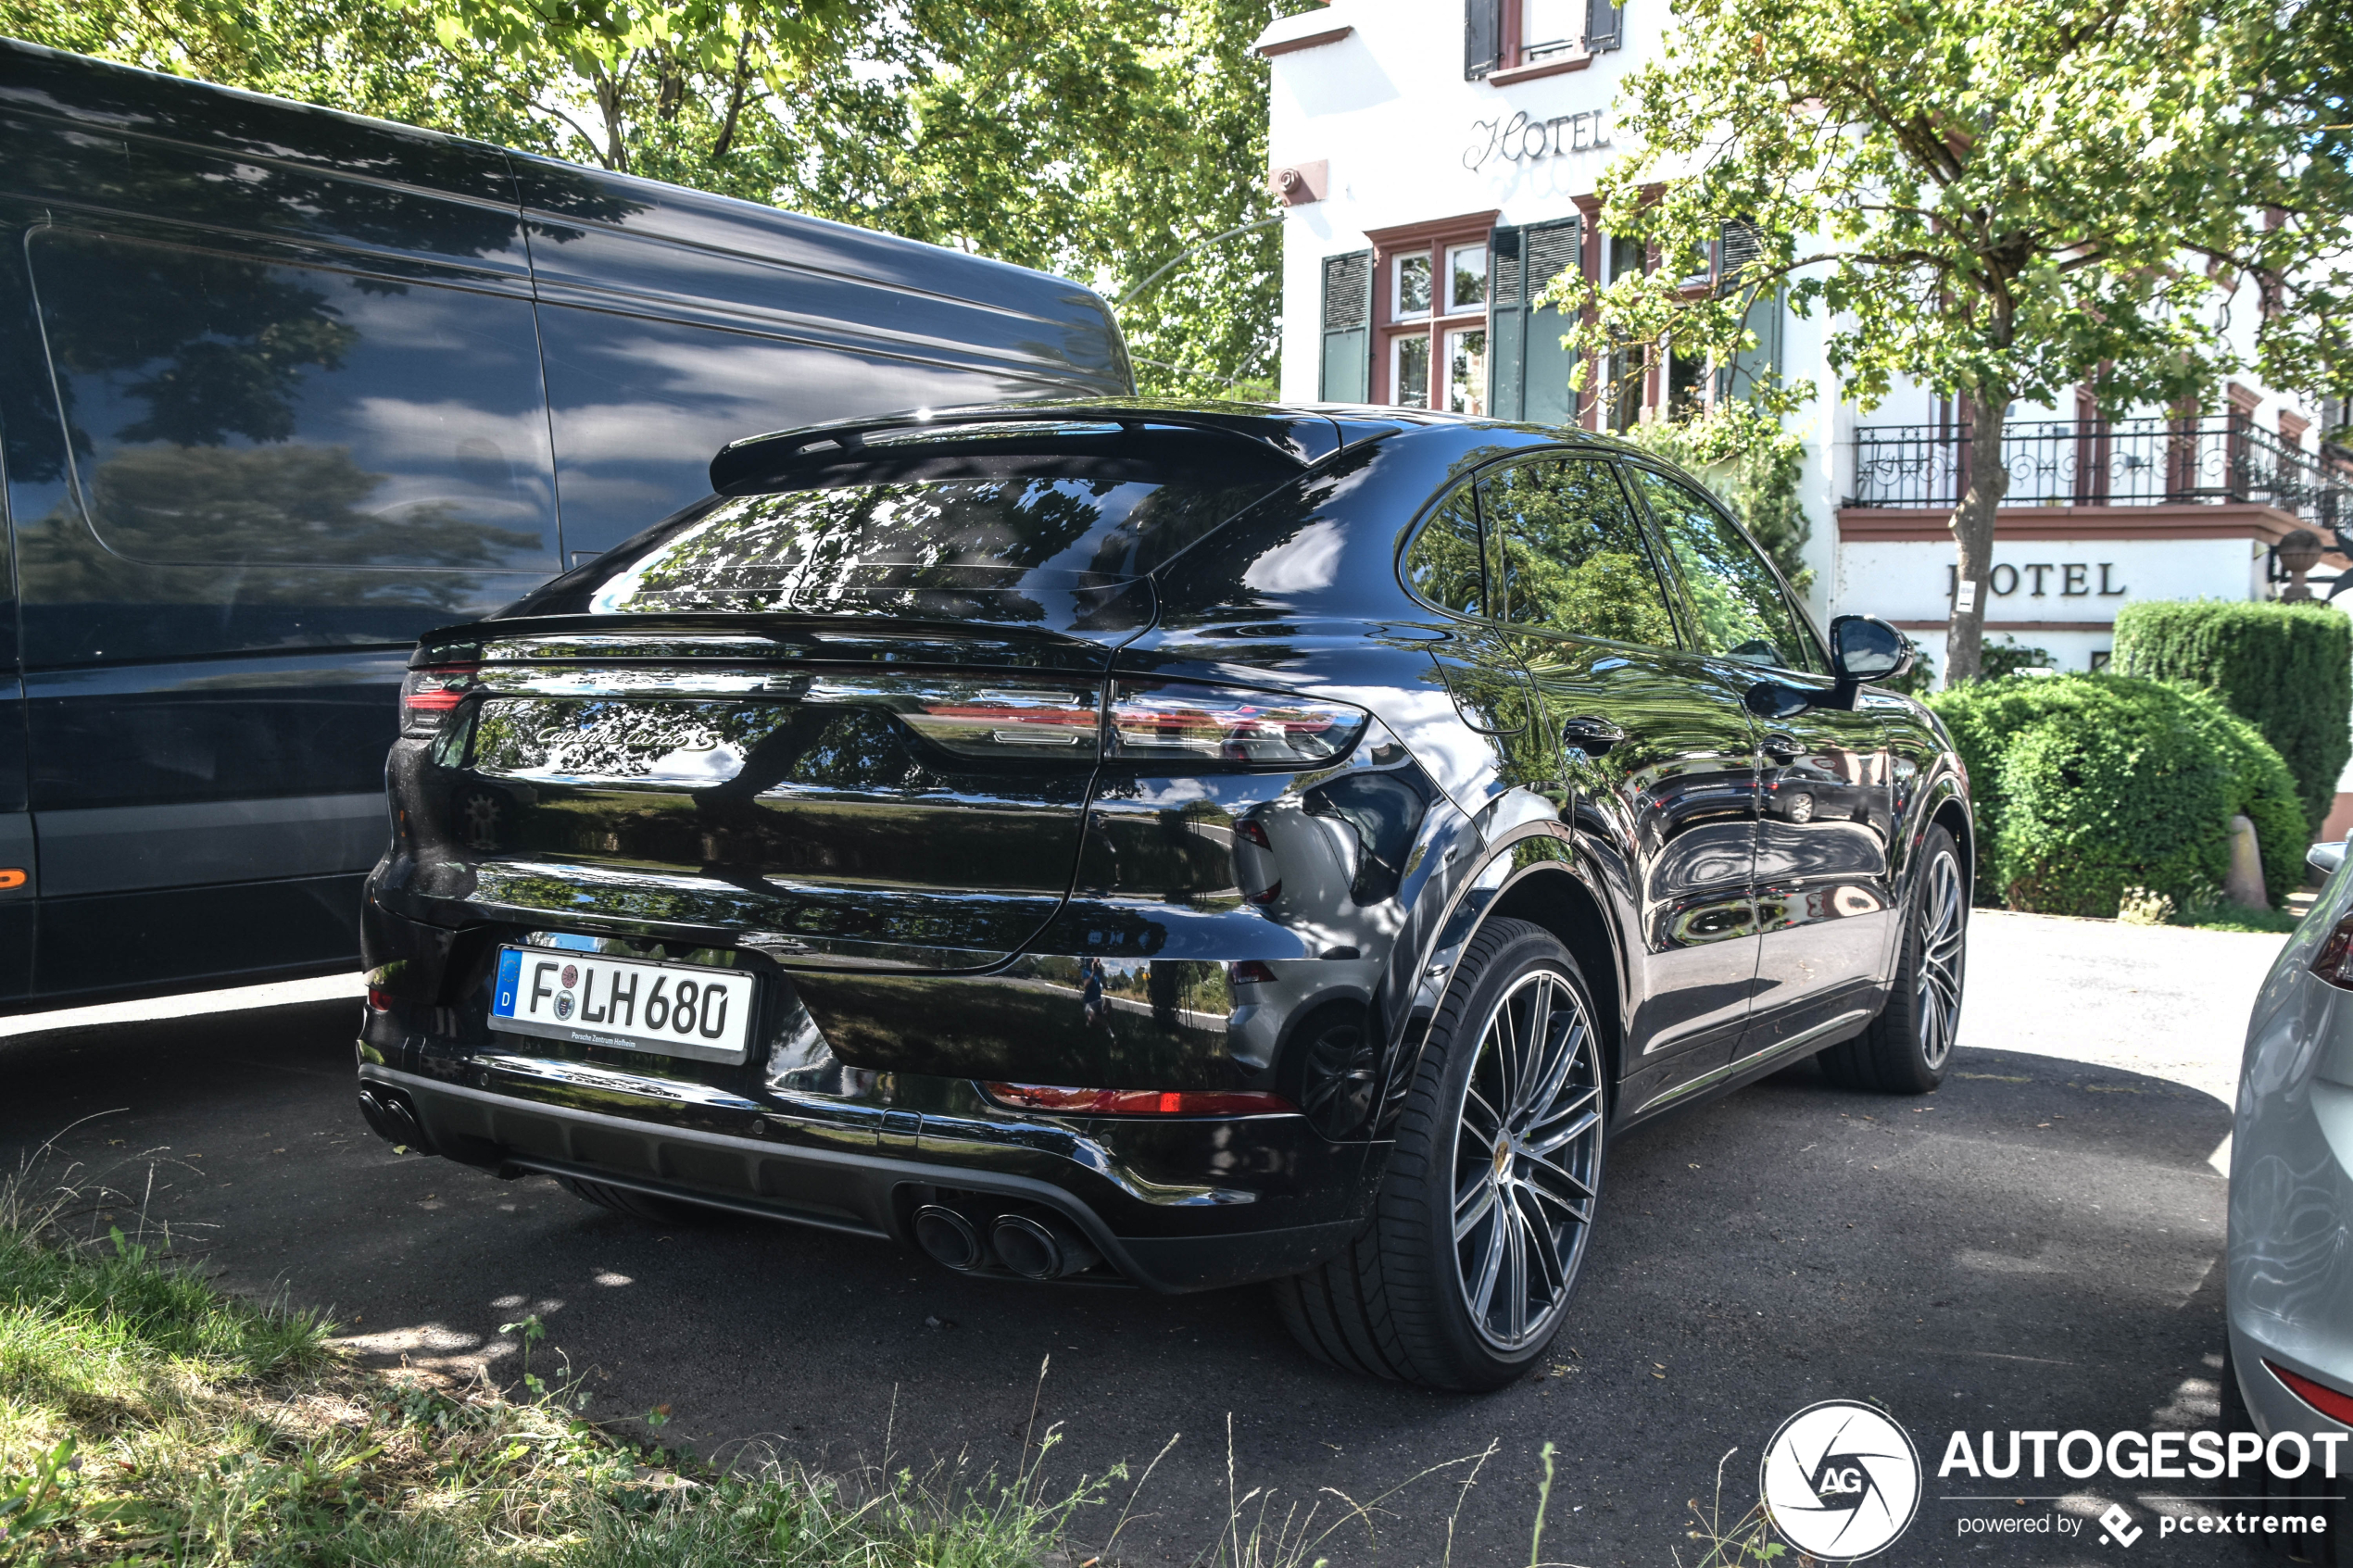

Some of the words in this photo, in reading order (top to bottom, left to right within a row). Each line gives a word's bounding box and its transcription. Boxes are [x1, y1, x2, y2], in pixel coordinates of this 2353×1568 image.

[1463, 108, 1611, 173] HOTEL
[535, 726, 621, 751] Cayenne
[623, 729, 689, 748] turbo
[682, 731, 724, 752] S
[501, 991, 510, 1008] D
[530, 961, 559, 1014] F
[581, 967, 639, 1027] LH
[645, 975, 728, 1039] 680
[572, 1031, 592, 1042] Porsche
[592, 1035, 613, 1046] Zentrum
[614, 1037, 636, 1048] Hofheim
